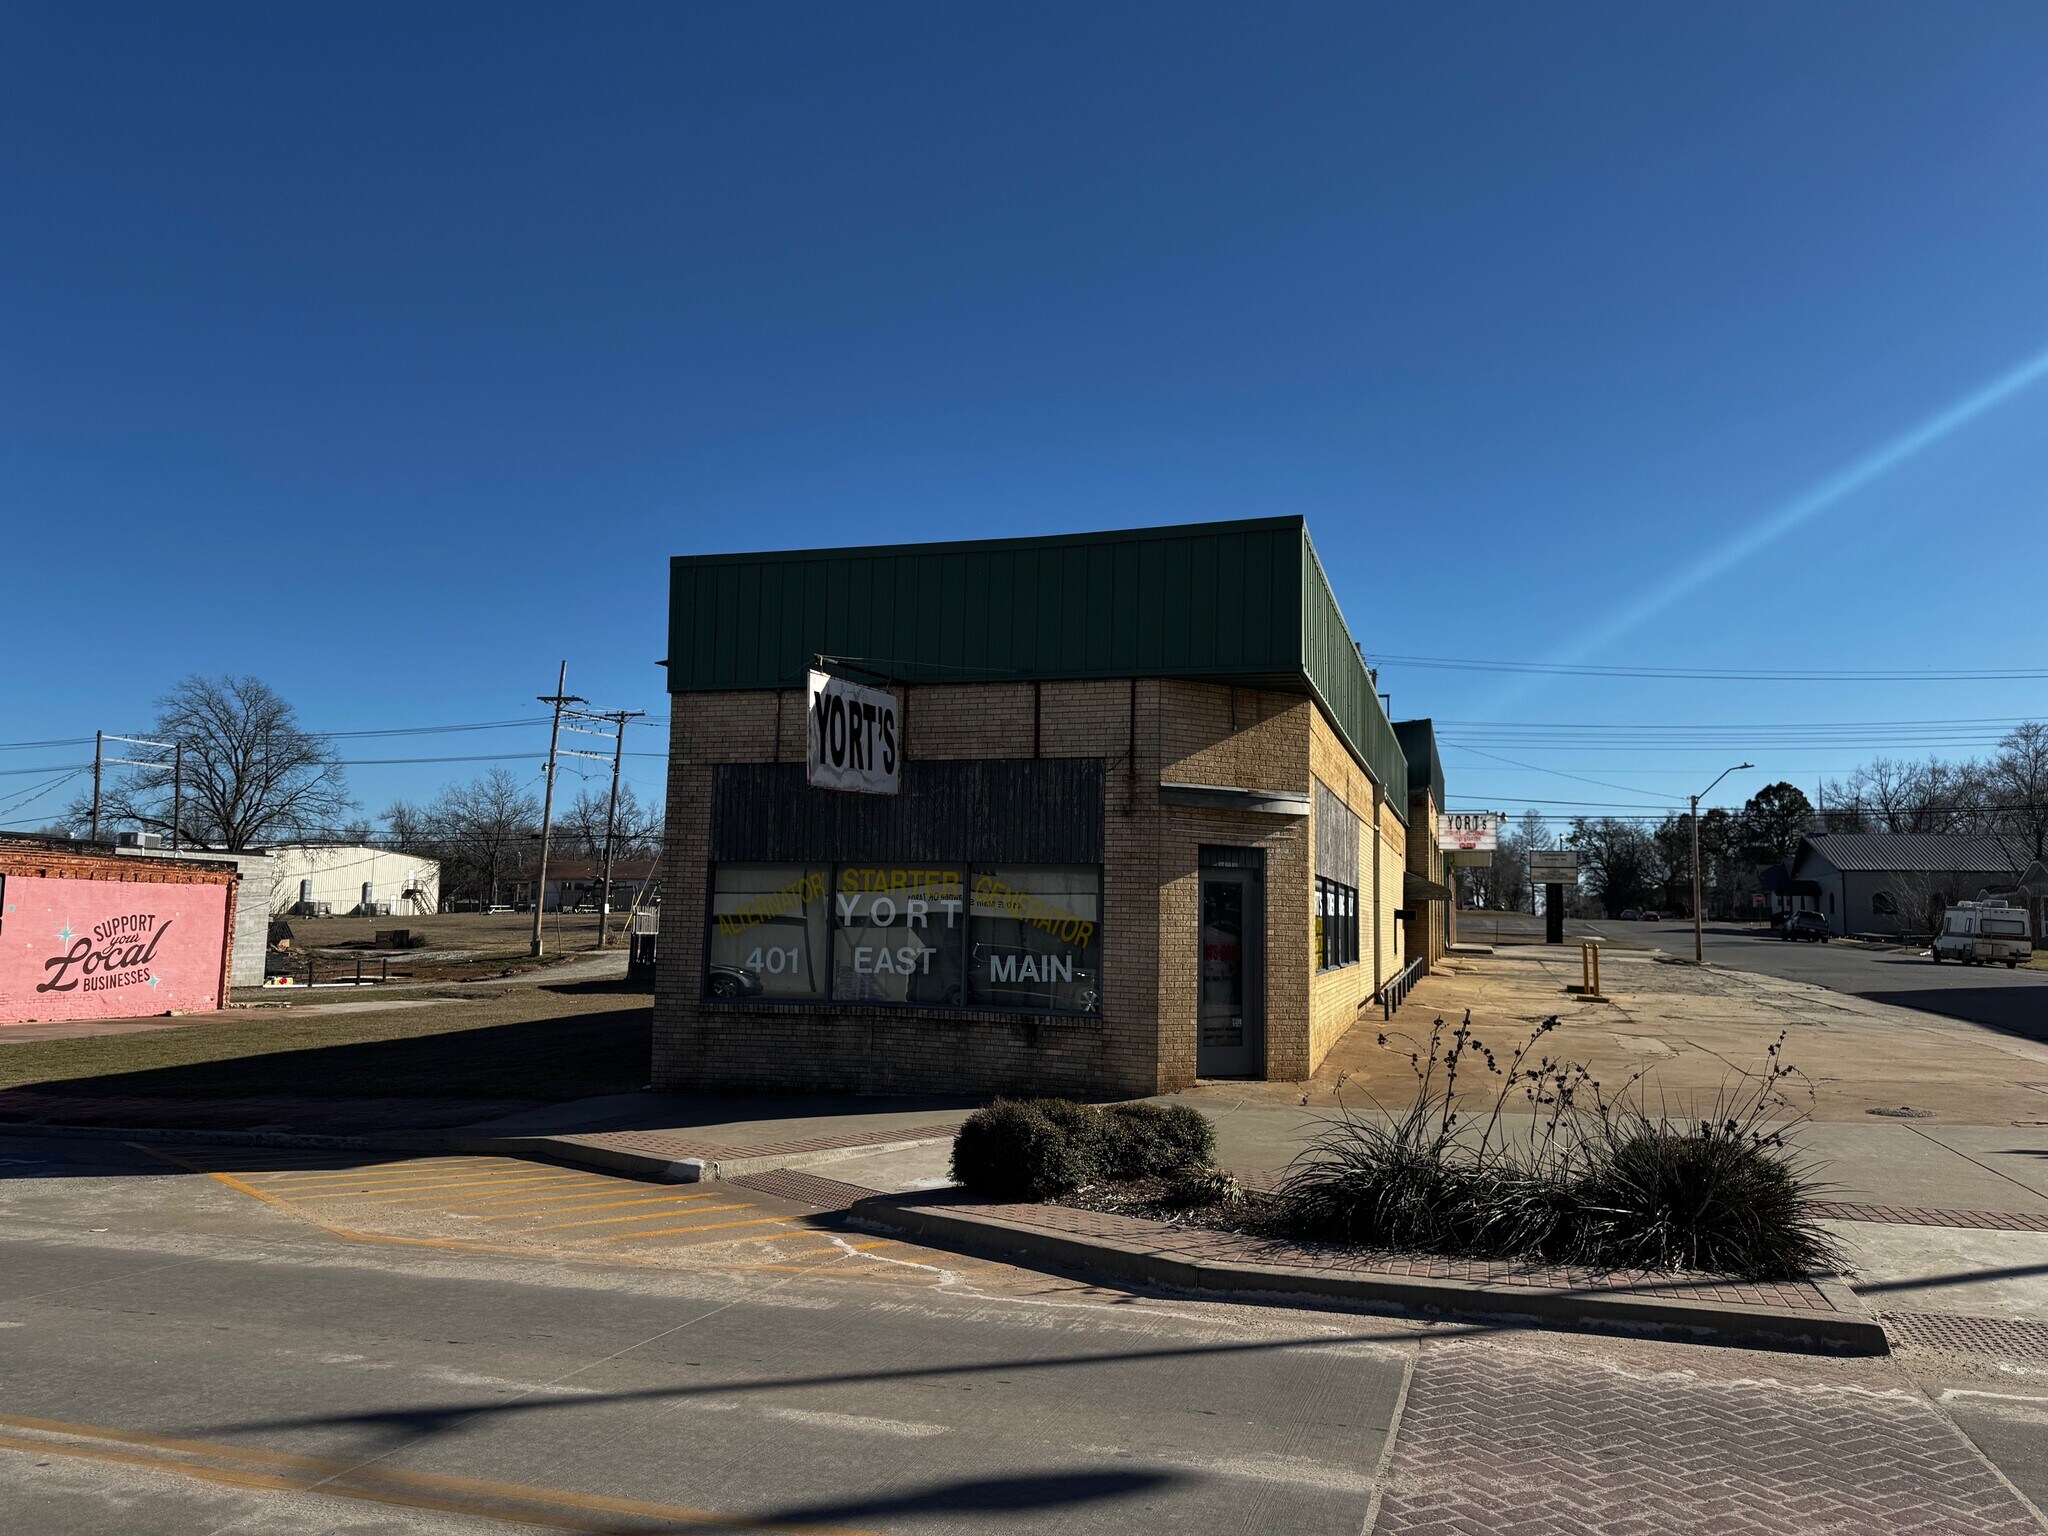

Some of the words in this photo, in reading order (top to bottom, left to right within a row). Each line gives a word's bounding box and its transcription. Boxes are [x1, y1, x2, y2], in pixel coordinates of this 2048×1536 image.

[814, 690, 896, 775] YORT'S
[717, 872, 826, 938] ALTERNATOR
[841, 868, 961, 894] STARTER
[975, 876, 1094, 949] GENERATOR
[837, 894, 963, 929] YORT
[94, 914, 156, 942] SUPPORT
[102, 933, 141, 954] your
[36, 920, 173, 993] Local
[746, 947, 800, 975] 401
[854, 947, 937, 975] EAST
[989, 954, 1073, 983] MAIN
[83, 967, 151, 992] BUSINESSES
